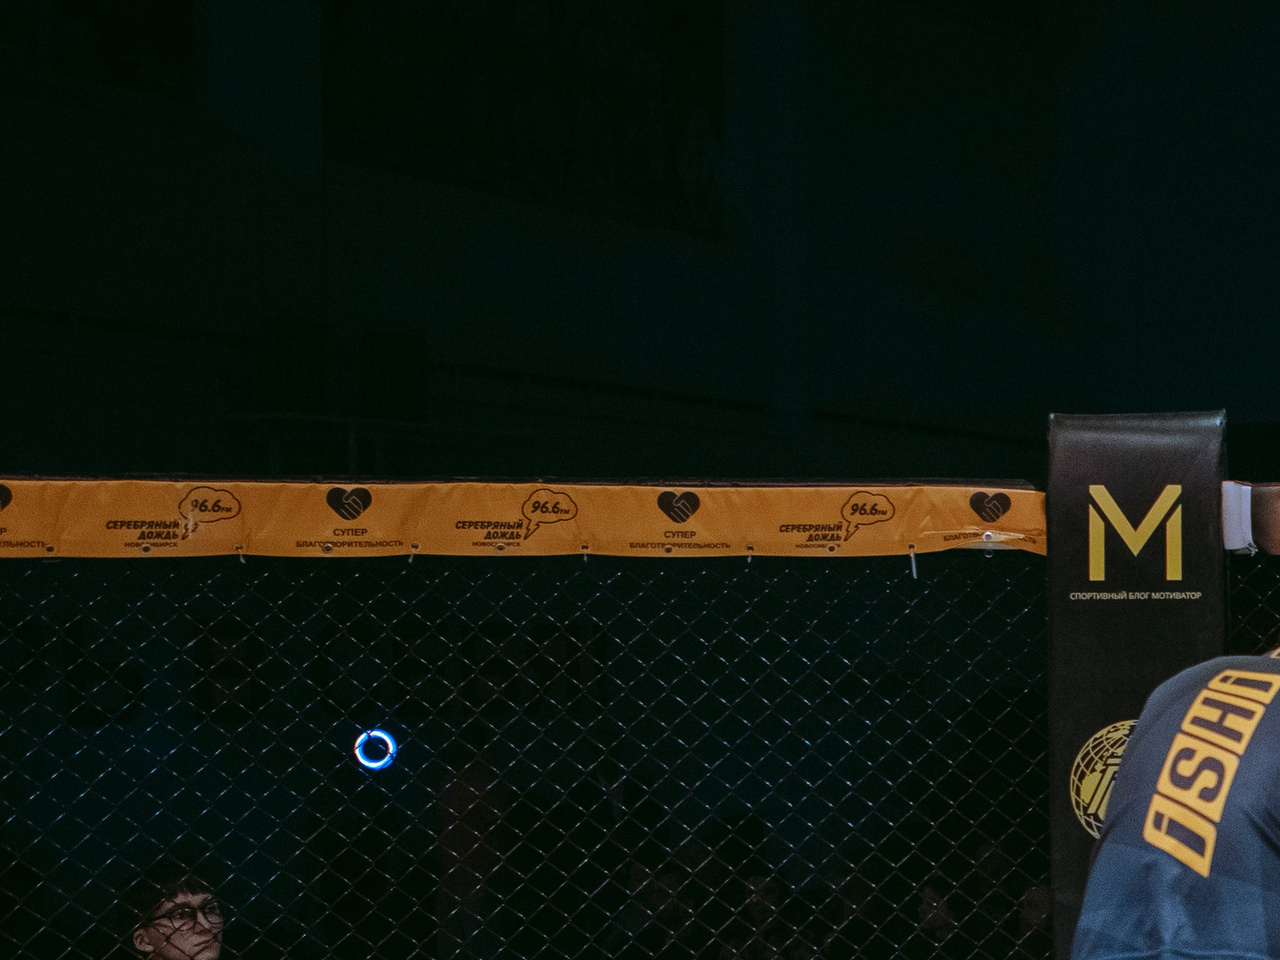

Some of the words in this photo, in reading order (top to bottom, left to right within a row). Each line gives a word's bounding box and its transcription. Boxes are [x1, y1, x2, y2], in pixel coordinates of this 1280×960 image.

[106, 518, 180, 530] СЕРЕБРЯНЫЙ
[455, 519, 524, 530] СЕРЕБРЯНЫЙ
[779, 521, 843, 533] СЕРЕБРЯНЫЙ
[137, 531, 179, 541] ДОЖДЬ
[333, 528, 368, 536] СУПЕР
[483, 530, 522, 540] ДОЖДЬ
[664, 530, 697, 539] СУПЕР
[806, 533, 842, 543] ДОЖДЬ
[1069, 590, 1128, 600] СПОРТИВНЫЙ
[1128, 592, 1150, 600] БЛОГ
[1151, 591, 1202, 600] МОТИВАТОР
